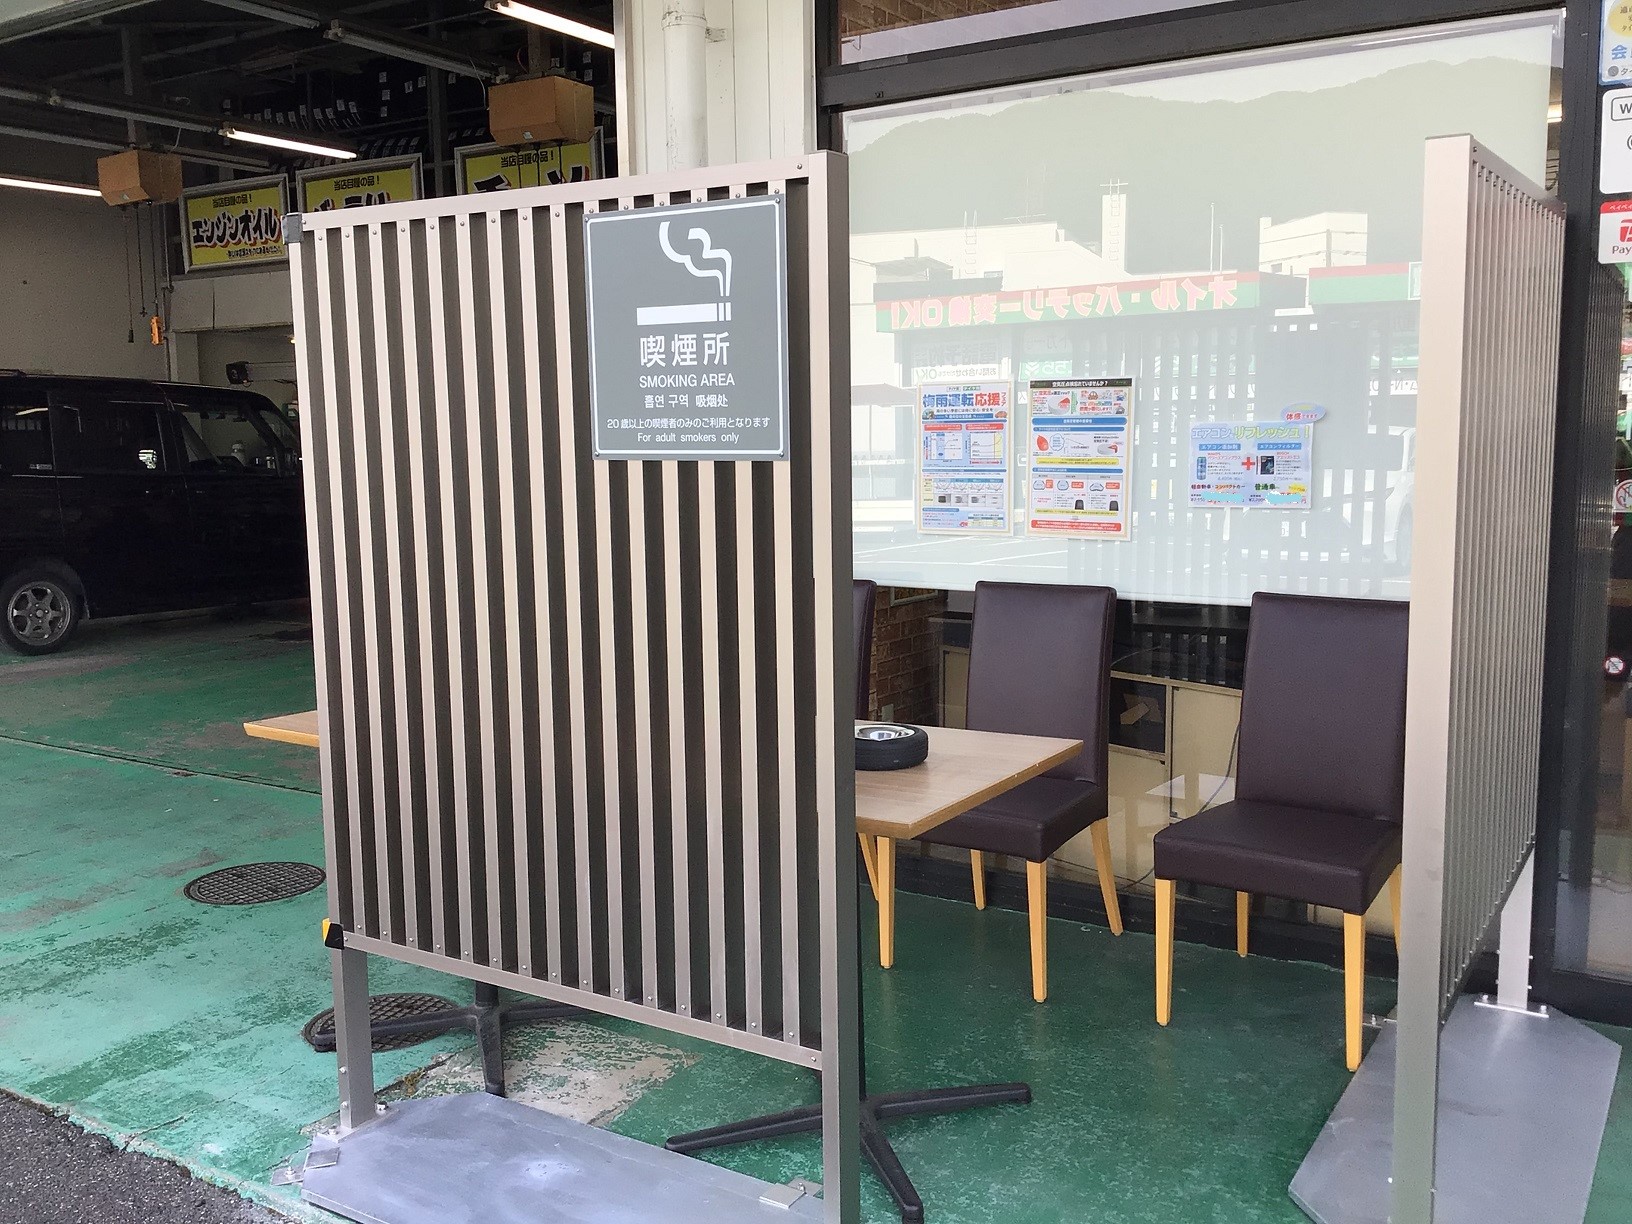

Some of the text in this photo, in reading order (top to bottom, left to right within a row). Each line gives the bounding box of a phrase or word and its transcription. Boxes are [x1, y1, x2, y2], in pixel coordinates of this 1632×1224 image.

[191, 206, 280, 246] エンジンオイル
[639, 331, 730, 368] 喫煙所
[639, 373, 736, 389] SMOKING AREA
[644, 393, 729, 409] 흡연 구역 吸烟处
[922, 391, 1001, 408] 梅雨運転応援
[637, 432, 740, 445] For adult smokers only
